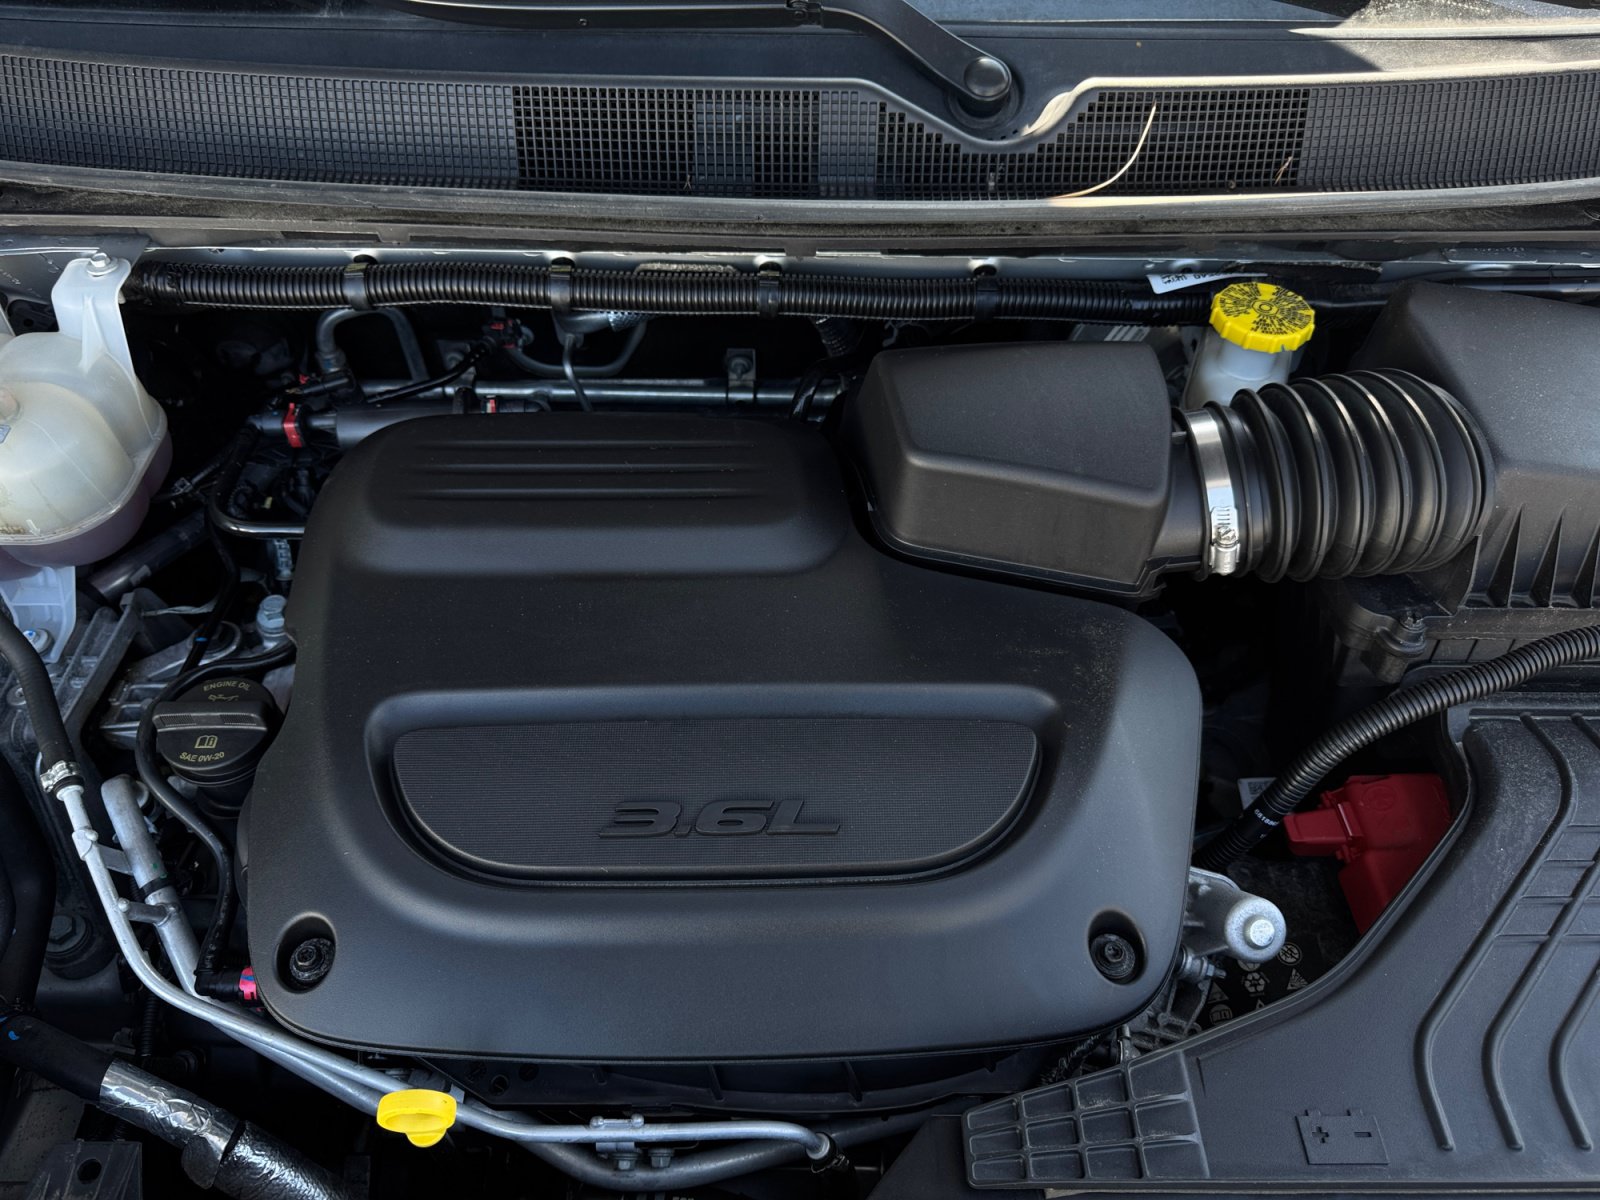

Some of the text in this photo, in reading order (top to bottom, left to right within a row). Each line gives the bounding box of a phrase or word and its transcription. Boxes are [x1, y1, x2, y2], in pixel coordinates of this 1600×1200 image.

[203, 681, 251, 692] ENGINE OIL
[180, 752, 224, 761] SAE 0W-20
[599, 799, 841, 838] 3.6L
